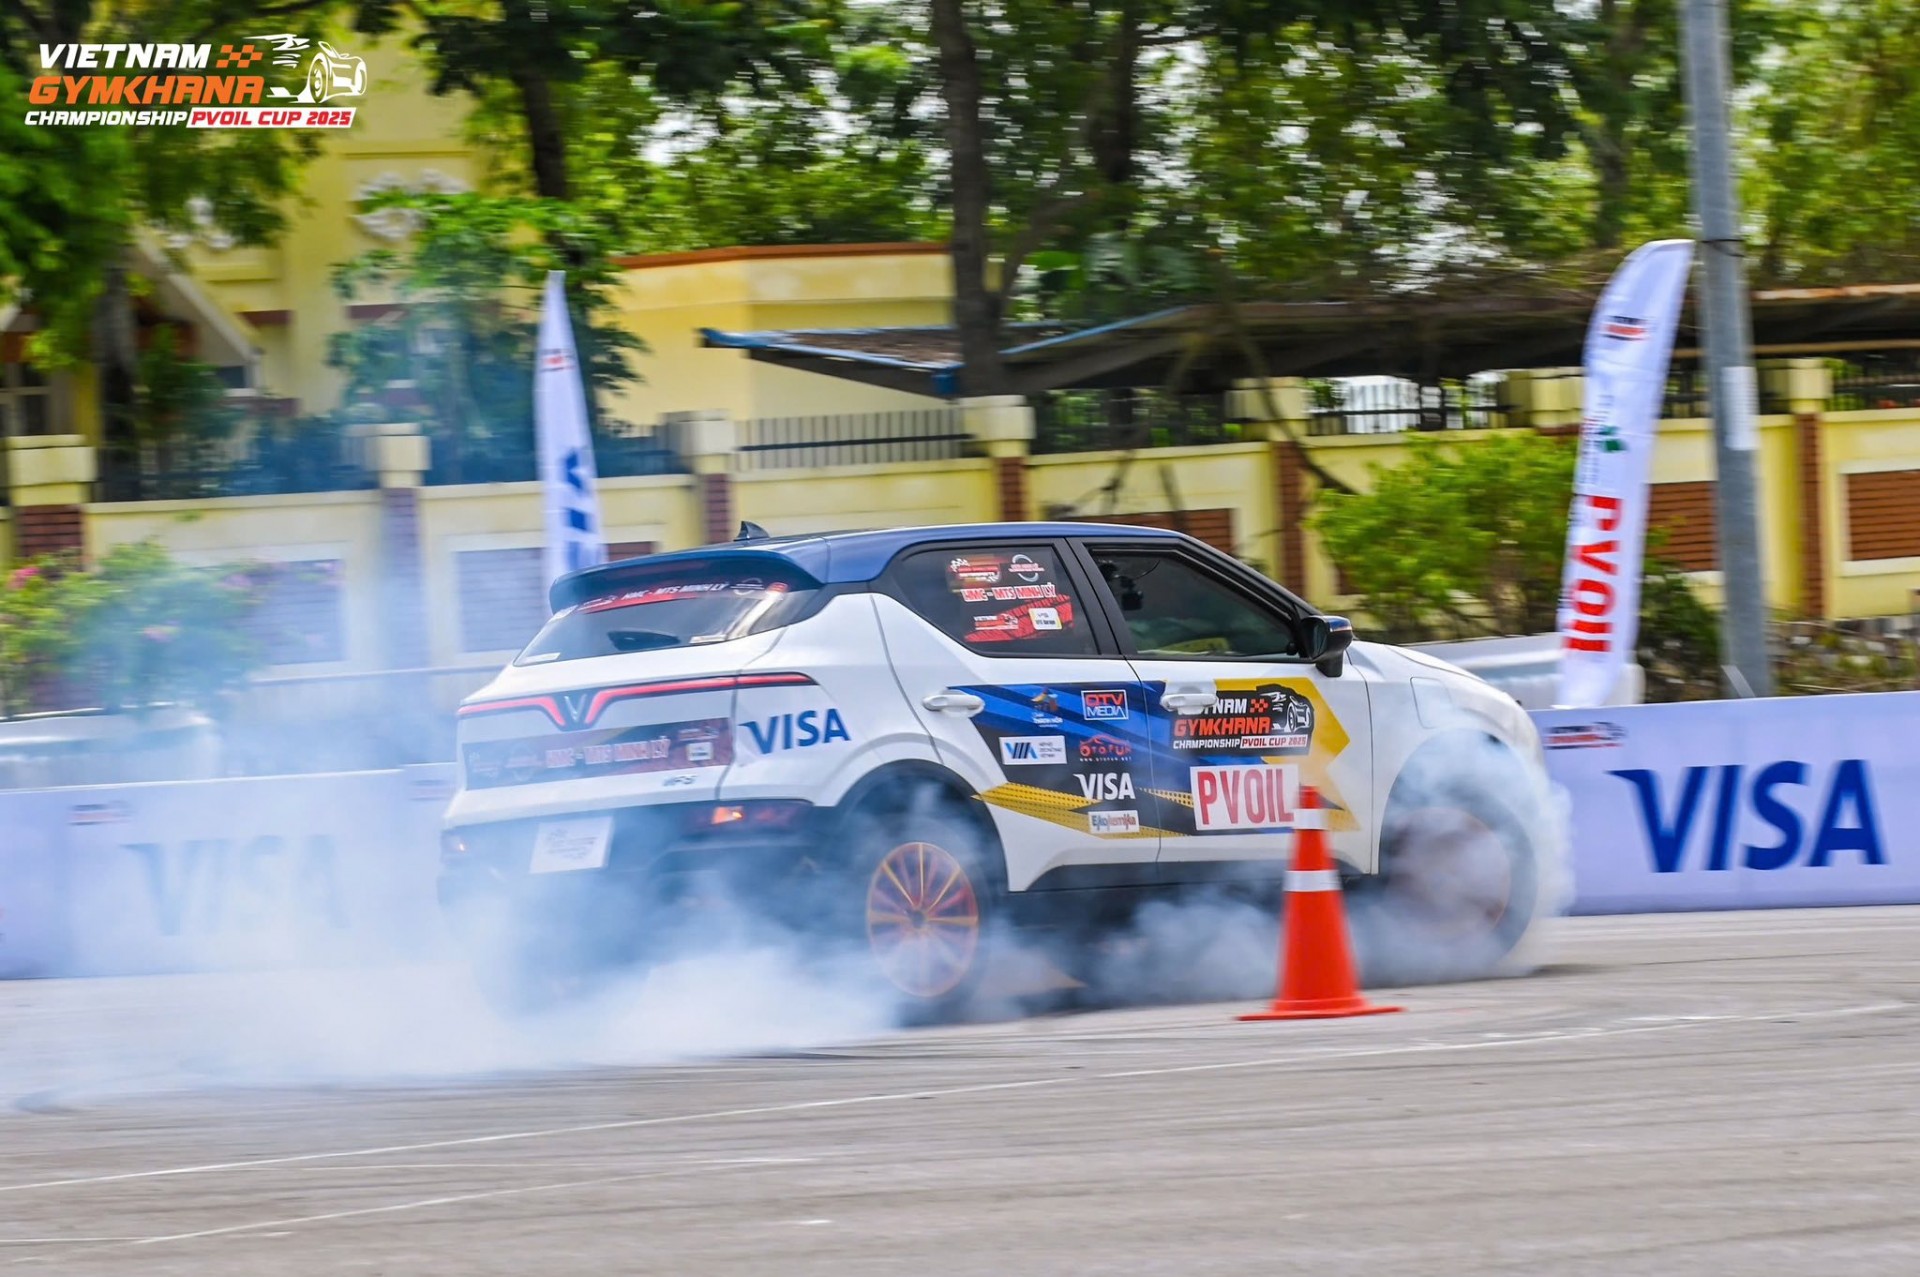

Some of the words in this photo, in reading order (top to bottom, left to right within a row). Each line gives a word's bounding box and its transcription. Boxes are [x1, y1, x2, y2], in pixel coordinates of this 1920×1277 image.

[739, 708, 851, 754] VISA
[1172, 738, 1240, 749] CHAMPIONSHIP
[1241, 738, 1267, 747] PVOIL
[1268, 737, 1287, 747] CUP
[1173, 717, 1271, 737] GYMKHANA
[1073, 772, 1136, 800] VISA
[1197, 768, 1294, 825] PVOIL
[1603, 758, 1889, 873] VISA
